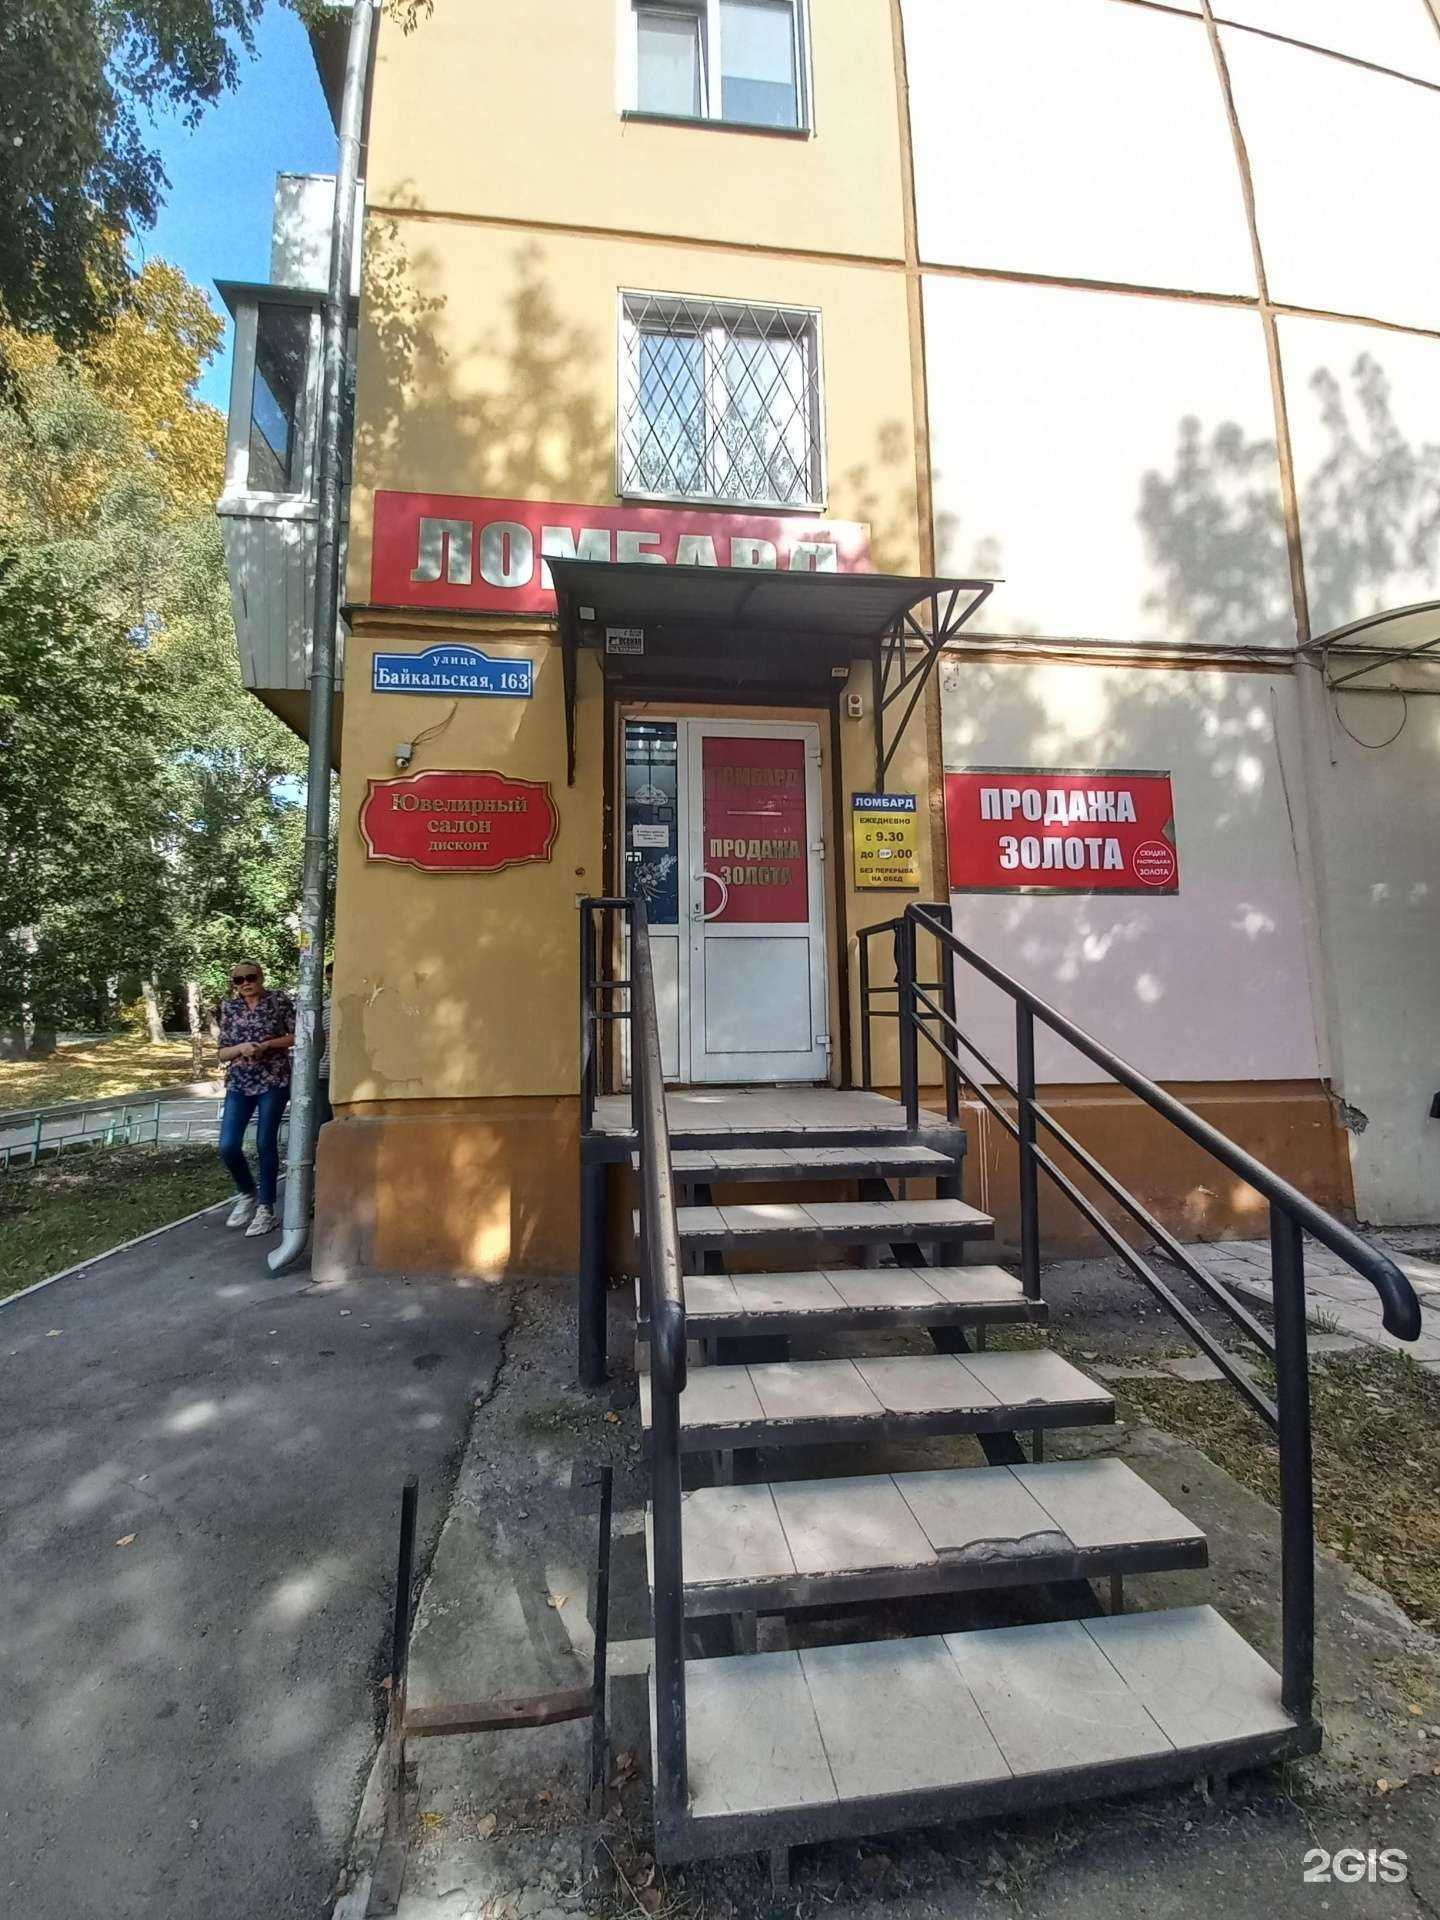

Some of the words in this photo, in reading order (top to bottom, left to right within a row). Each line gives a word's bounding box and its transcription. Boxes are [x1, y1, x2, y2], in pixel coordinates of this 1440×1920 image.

[433, 655, 477, 666] улица
[378, 667, 494, 690] Байкальская,
[500, 672, 528, 689] 163
[391, 793, 528, 816] Ювелирный
[855, 797, 914, 809] ЛОМБАРД
[979, 788, 1137, 827] ПРОДАЖА
[427, 819, 492, 833] салон
[859, 817, 911, 825] ЕЖЕДНЕВНО
[876, 832, 904, 841] 9.30
[428, 840, 489, 852] дисконт
[710, 838, 800, 861] ПРОДАЖА
[999, 835, 1125, 870] ЗОЛОТА
[860, 851, 873, 859] до
[877, 849, 912, 859] .00
[720, 865, 792, 886] ЗОЛОТА
[1140, 868, 1169, 876] ЗОЛОТА
